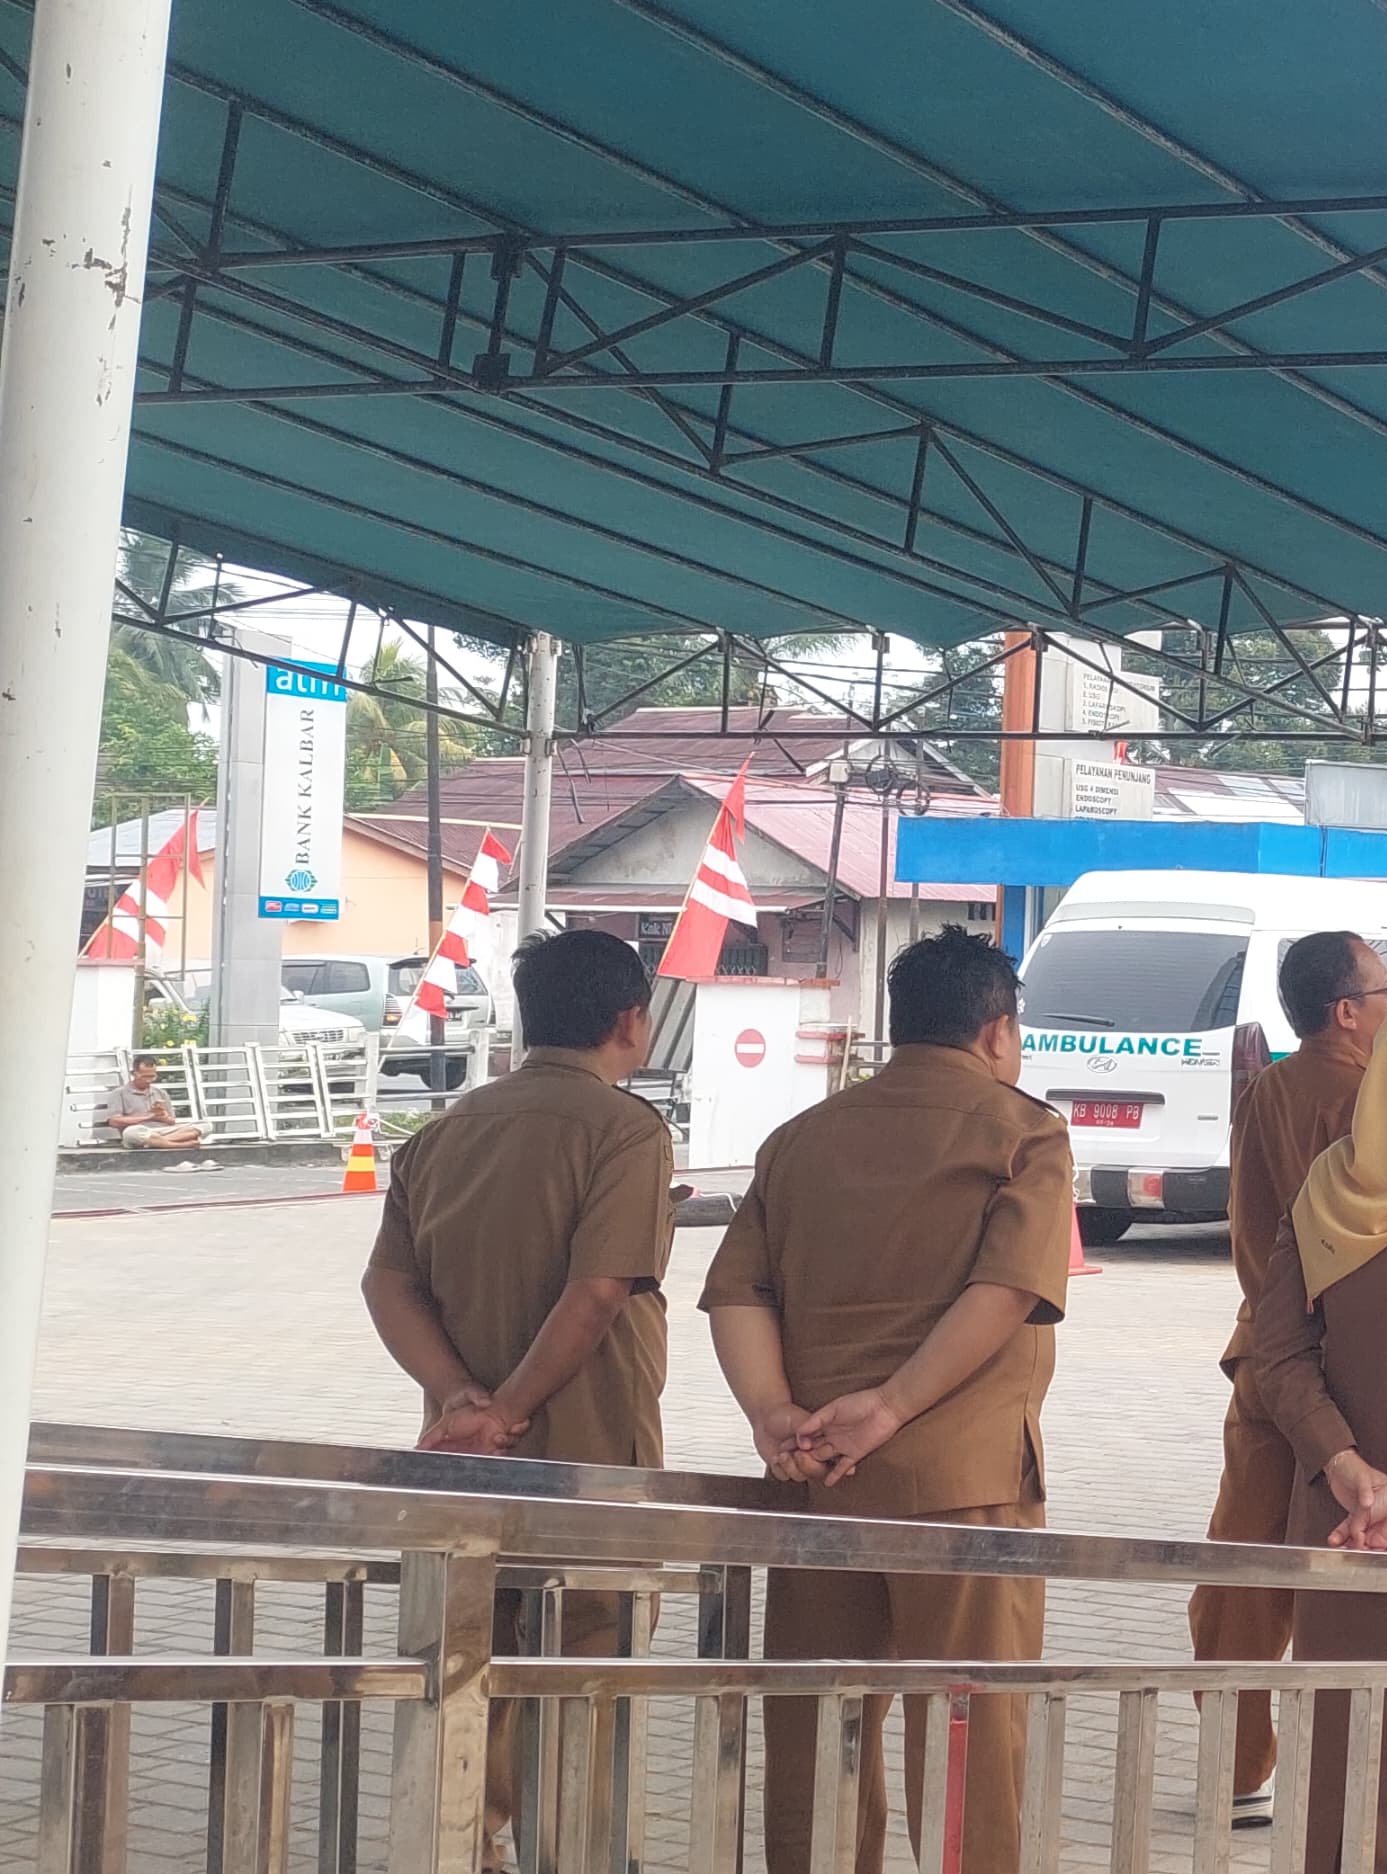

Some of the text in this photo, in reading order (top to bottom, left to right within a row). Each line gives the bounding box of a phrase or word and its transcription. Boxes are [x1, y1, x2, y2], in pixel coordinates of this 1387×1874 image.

[1075, 763, 1152, 785] PELAYANAN PENUNJANG
[295, 708, 315, 864] BANK KALBAR
[1075, 794, 1112, 805] ENDOSCOPY
[1022, 1034, 1202, 1057] AMBULANCE
[1073, 1103, 1086, 1118] KB
[1126, 1105, 1140, 1120] PB
